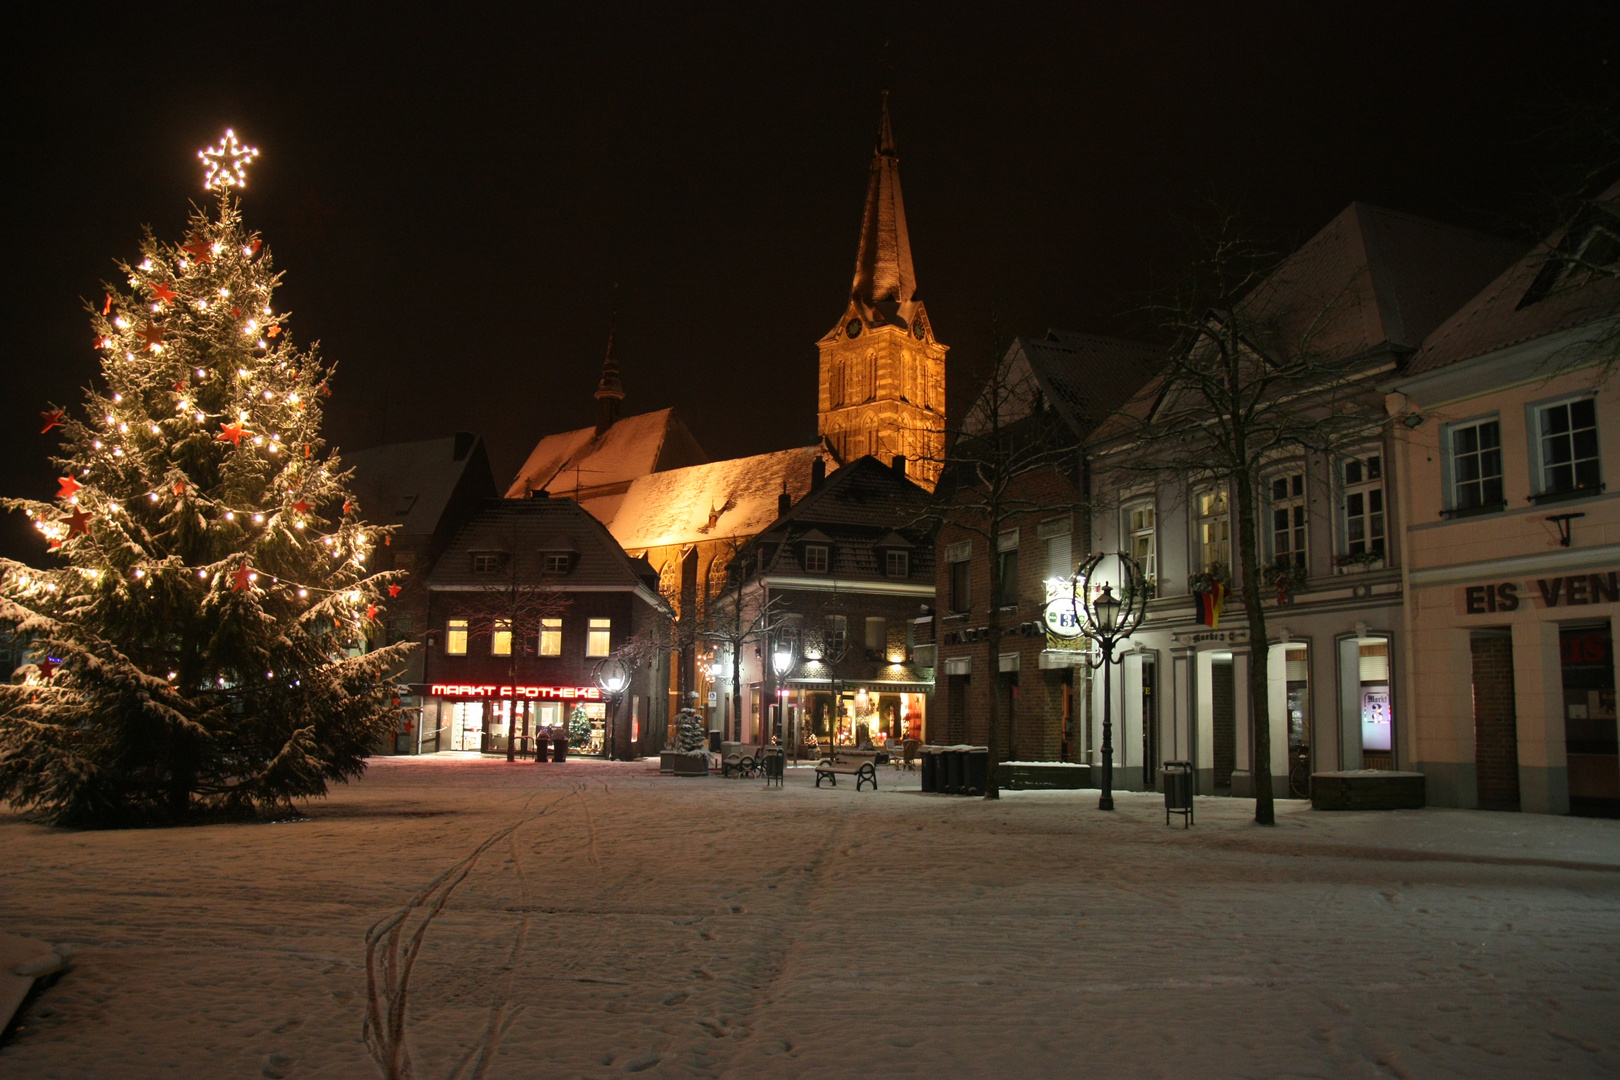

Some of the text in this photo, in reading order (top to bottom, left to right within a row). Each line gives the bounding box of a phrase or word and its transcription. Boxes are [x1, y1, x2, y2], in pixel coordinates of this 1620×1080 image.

[1466, 571, 1619, 614] EIS VEN
[1193, 632, 1218, 643] Markt
[1219, 633, 1225, 641] 3
[431, 685, 600, 699] MARKT APOTHEKE
[1367, 695, 1387, 703] Markt
